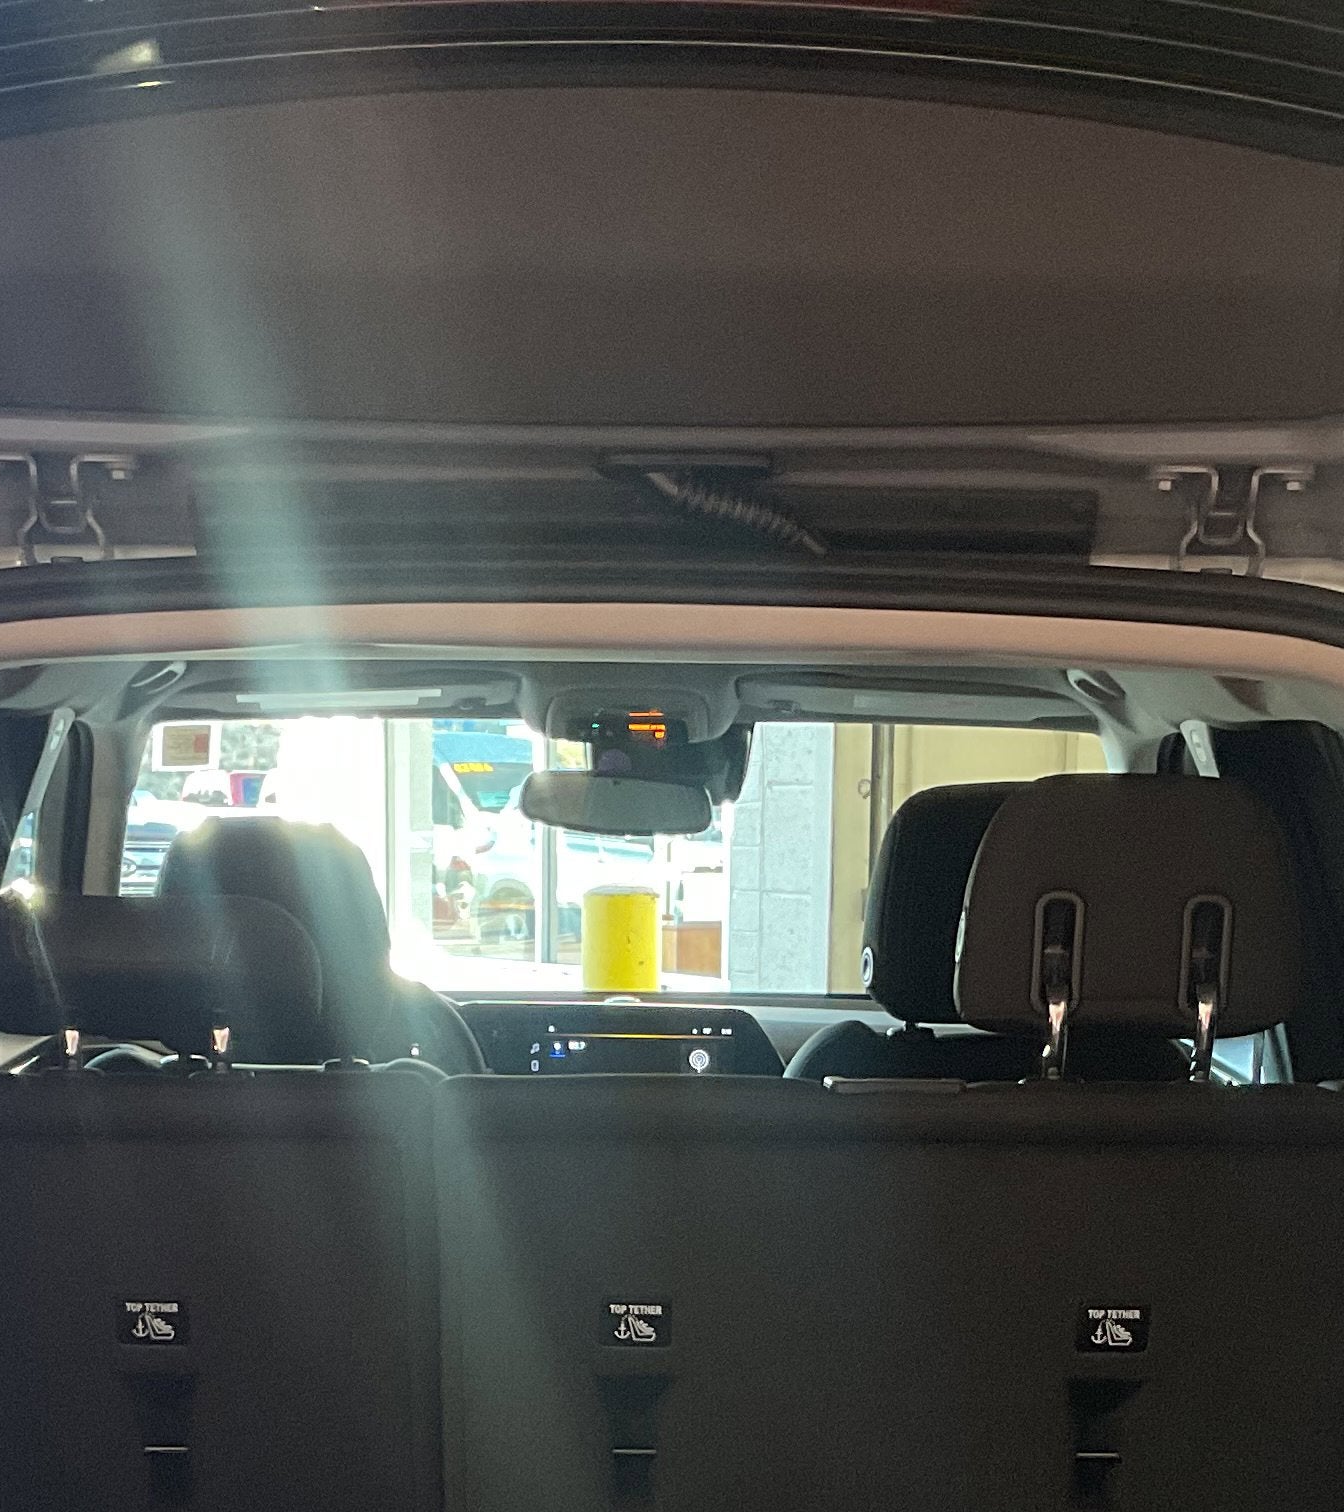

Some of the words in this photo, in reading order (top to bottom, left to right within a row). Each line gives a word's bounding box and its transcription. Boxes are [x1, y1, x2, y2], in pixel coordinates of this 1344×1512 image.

[125, 1302, 143, 1312] TOP
[144, 1302, 178, 1312] TETHER
[609, 1304, 627, 1314] TOP
[628, 1304, 662, 1315] TETHER
[1088, 1309, 1105, 1319] TOP
[1107, 1309, 1140, 1319] TETHER
